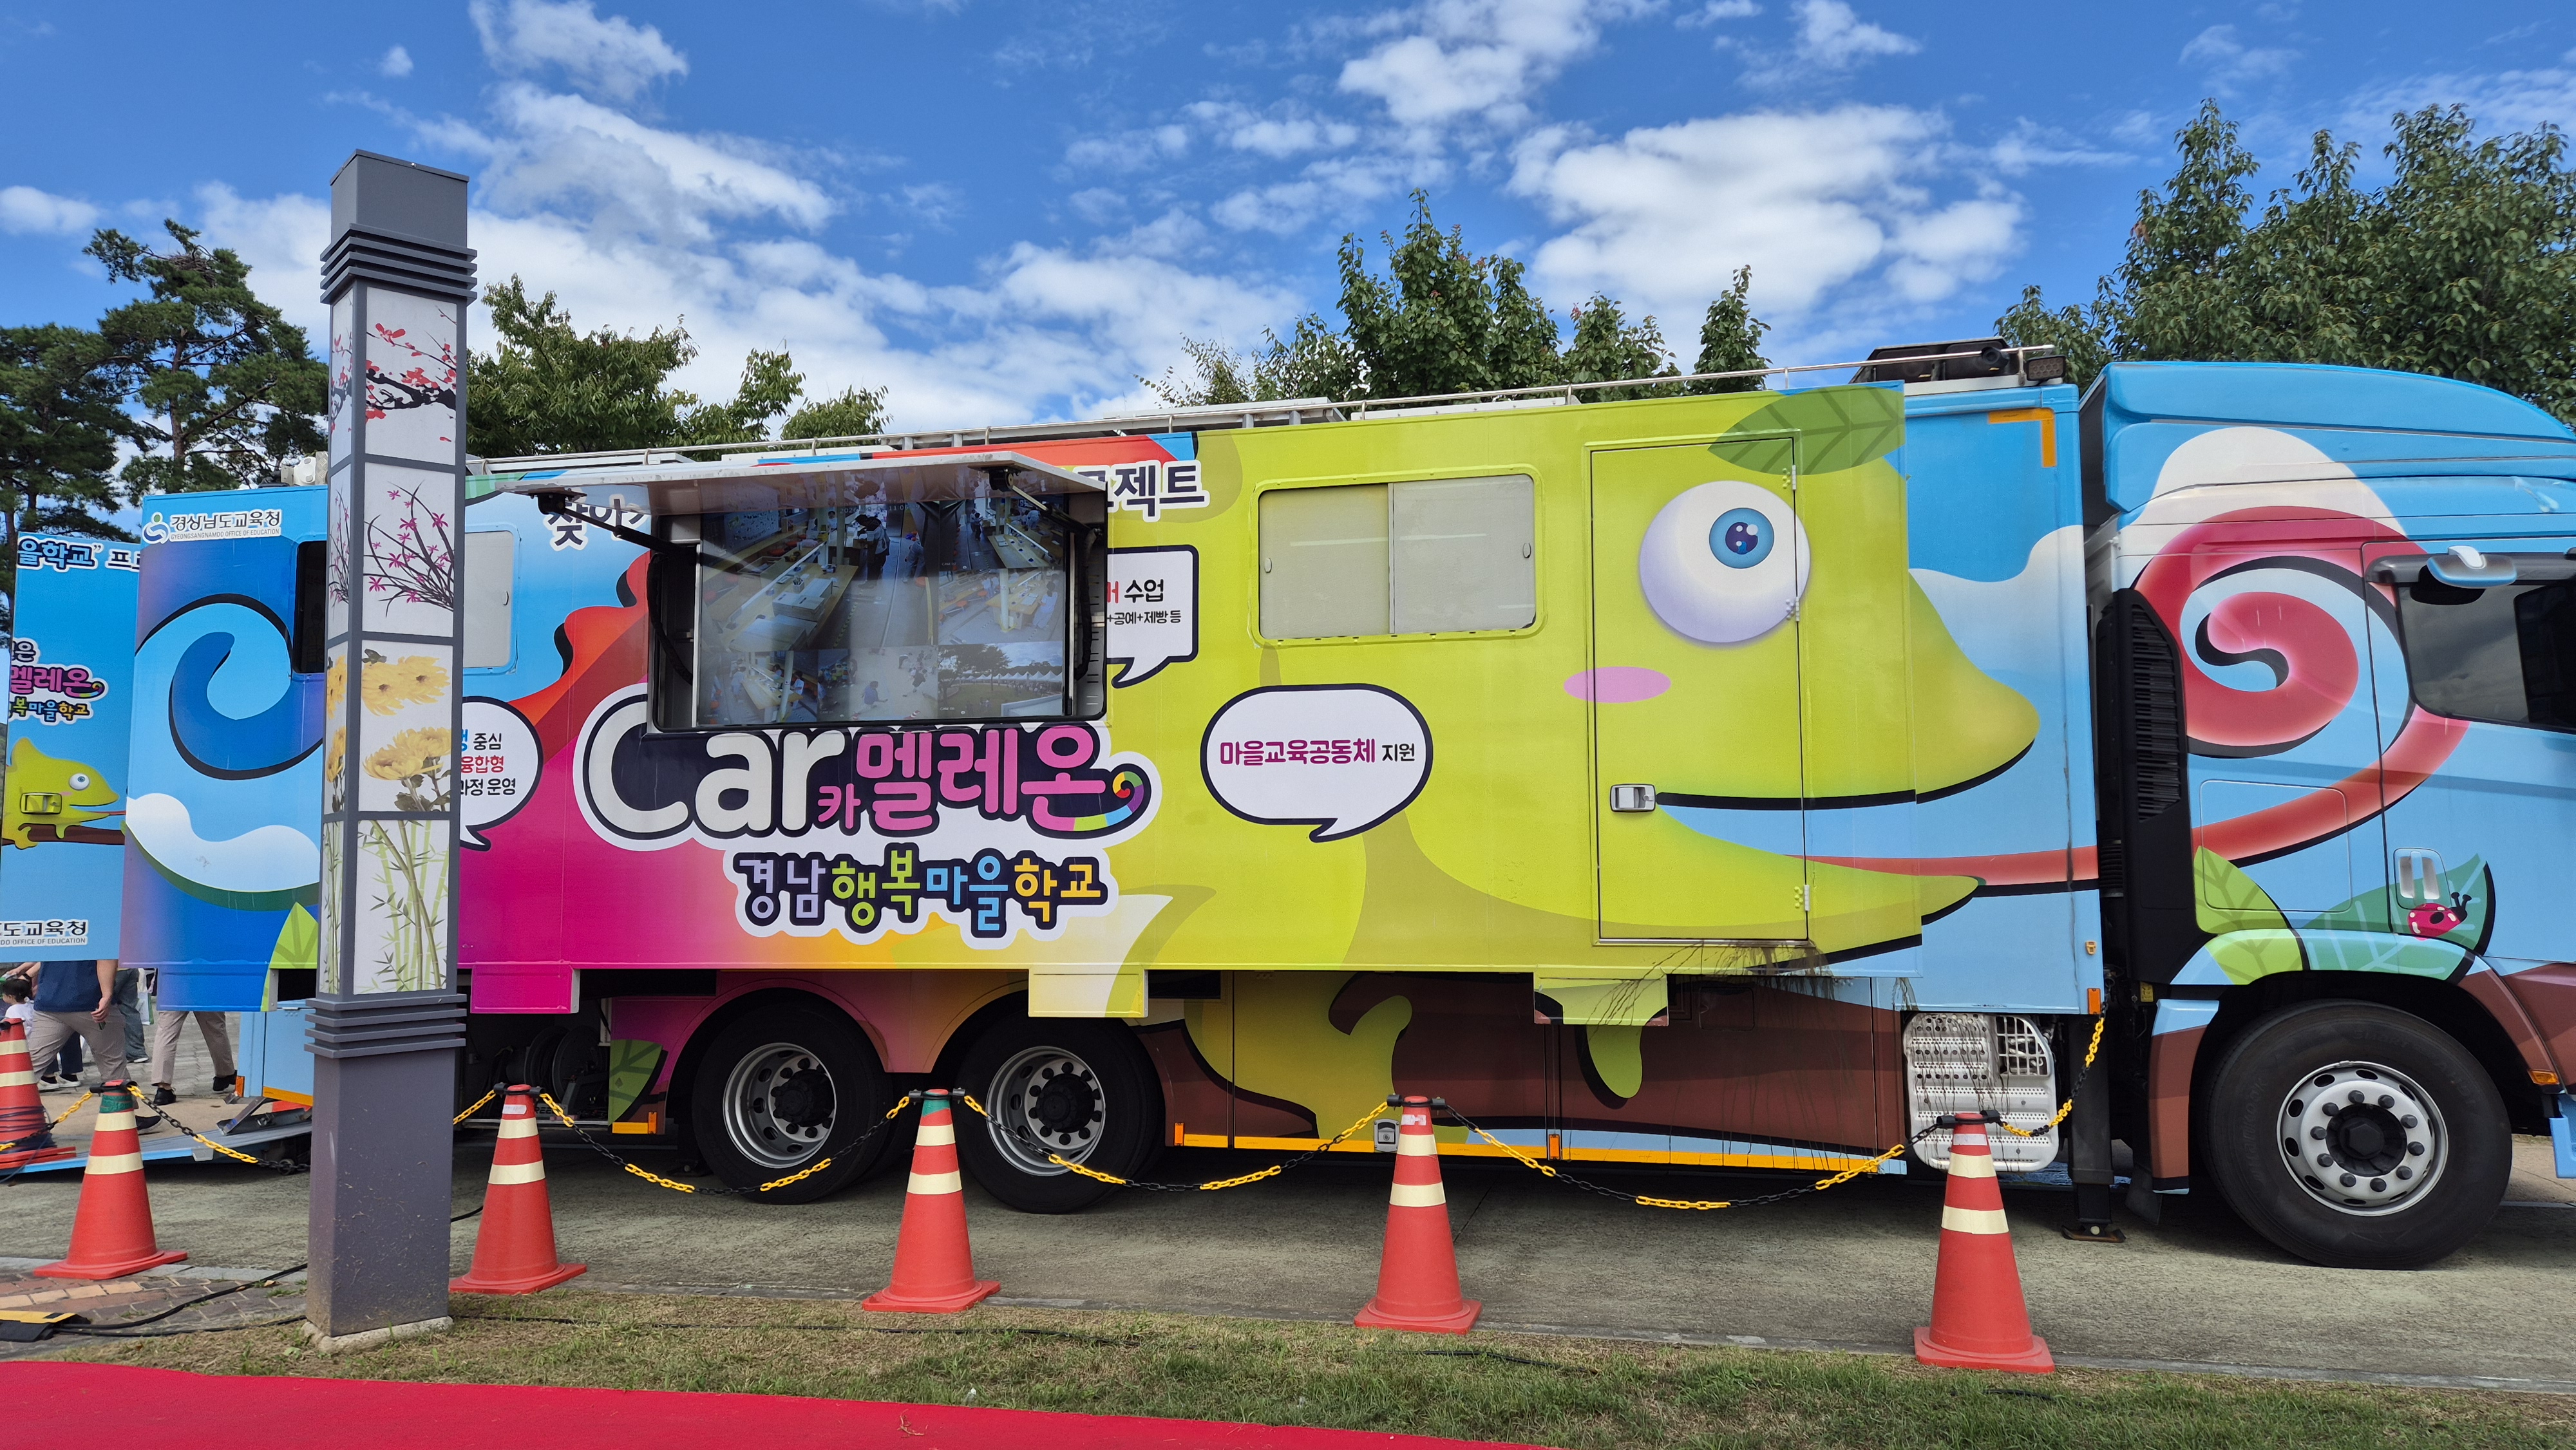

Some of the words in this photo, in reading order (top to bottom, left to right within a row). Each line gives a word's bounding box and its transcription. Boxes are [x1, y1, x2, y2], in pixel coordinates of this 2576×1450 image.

[1078, 465, 1205, 516] 젝트
[171, 511, 280, 531] 경상남도교육청
[547, 498, 645, 546] 찾아
[171, 531, 224, 540] GYEONGSANGNAMDO
[108, 551, 140, 569] 프
[1124, 579, 1164, 603] 수업
[1170, 610, 1181, 623] 등
[12, 641, 35, 662] 은
[9, 697, 89, 720] 복마을학교
[473, 733, 502, 750] 중심
[1220, 738, 1376, 766] 마을교육공동체
[1381, 742, 1416, 762] 지원
[461, 755, 504, 773] 융합형
[487, 777, 516, 796] 운영
[0, 921, 86, 936] 도교육청
